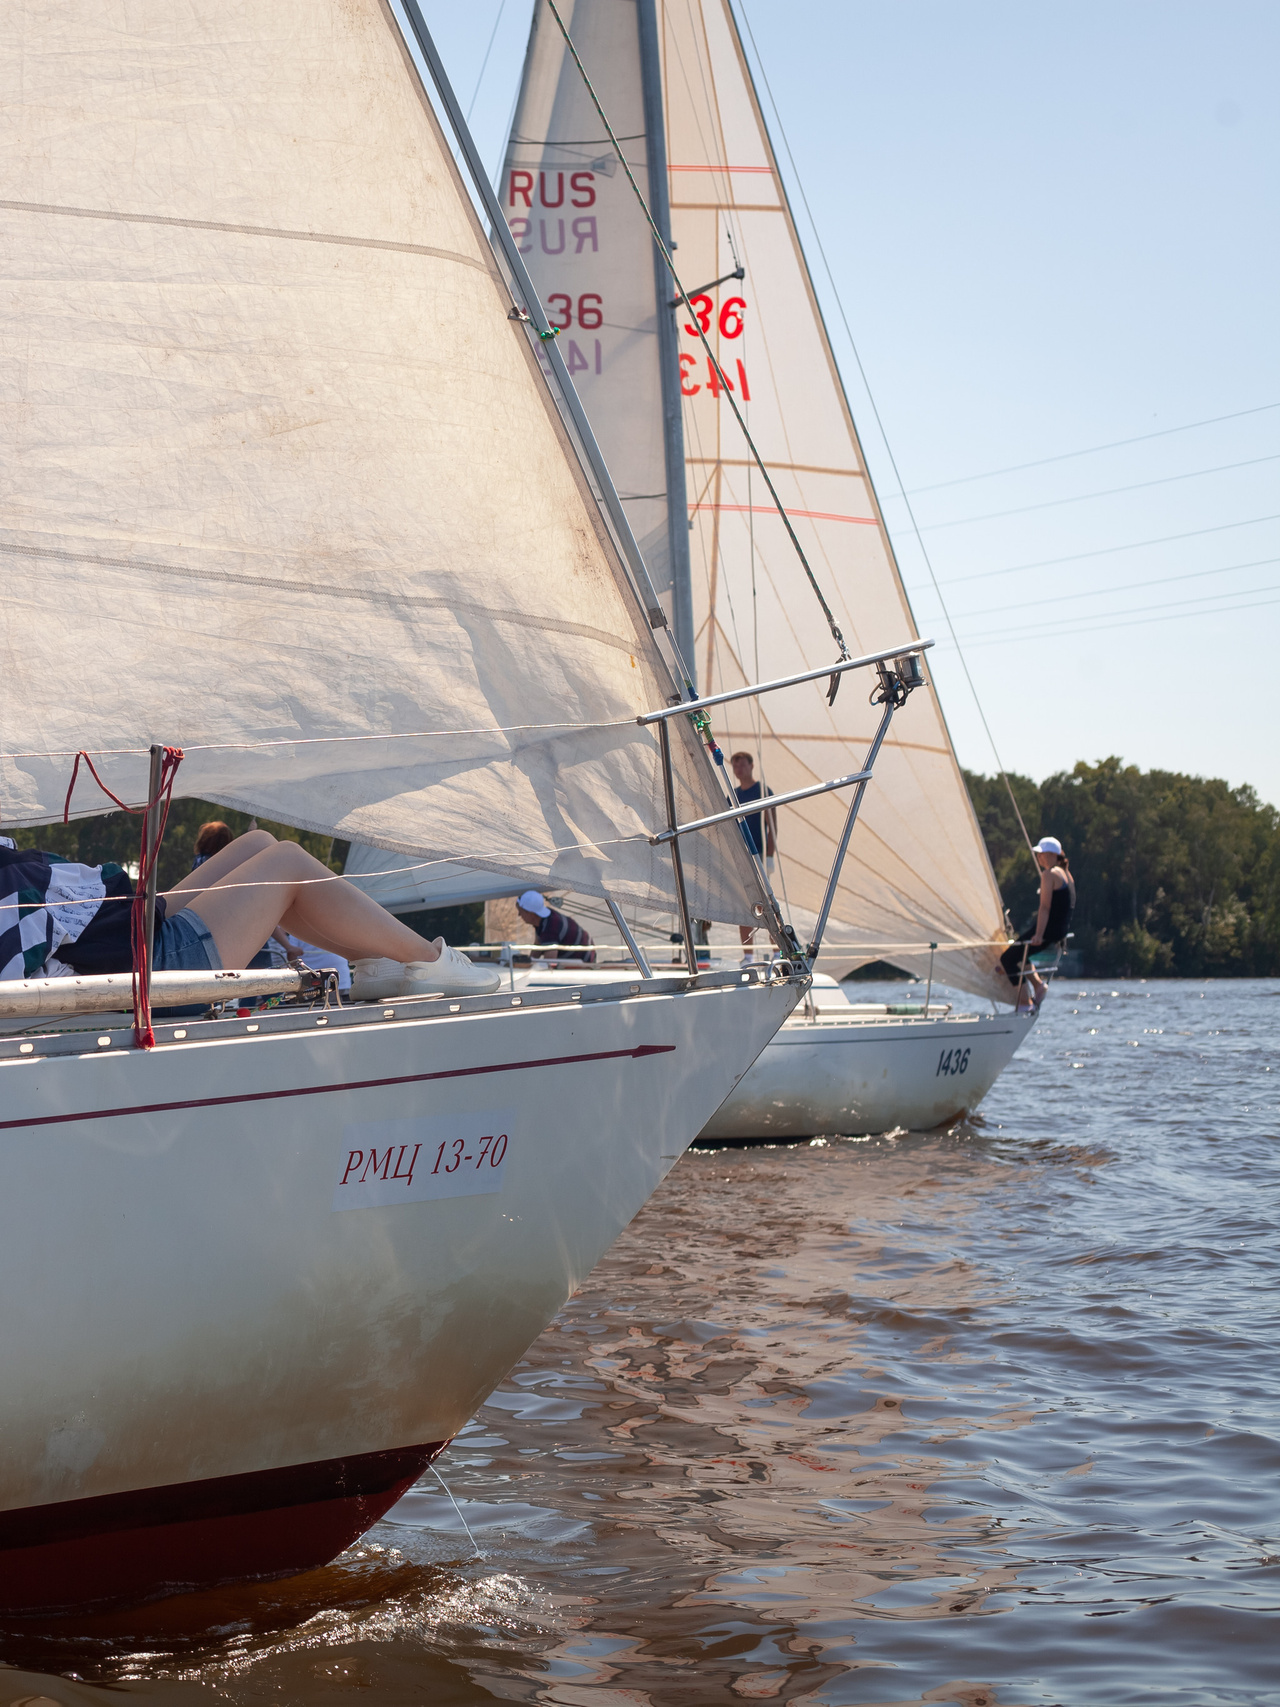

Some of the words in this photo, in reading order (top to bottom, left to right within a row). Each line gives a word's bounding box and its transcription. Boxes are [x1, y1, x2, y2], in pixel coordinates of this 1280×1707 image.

[509, 170, 596, 208] RUS
[675, 293, 747, 339] 36
[936, 1047, 971, 1077] 1436
[339, 1143, 423, 1186] РМЦ
[430, 1134, 508, 1175] 13-70
